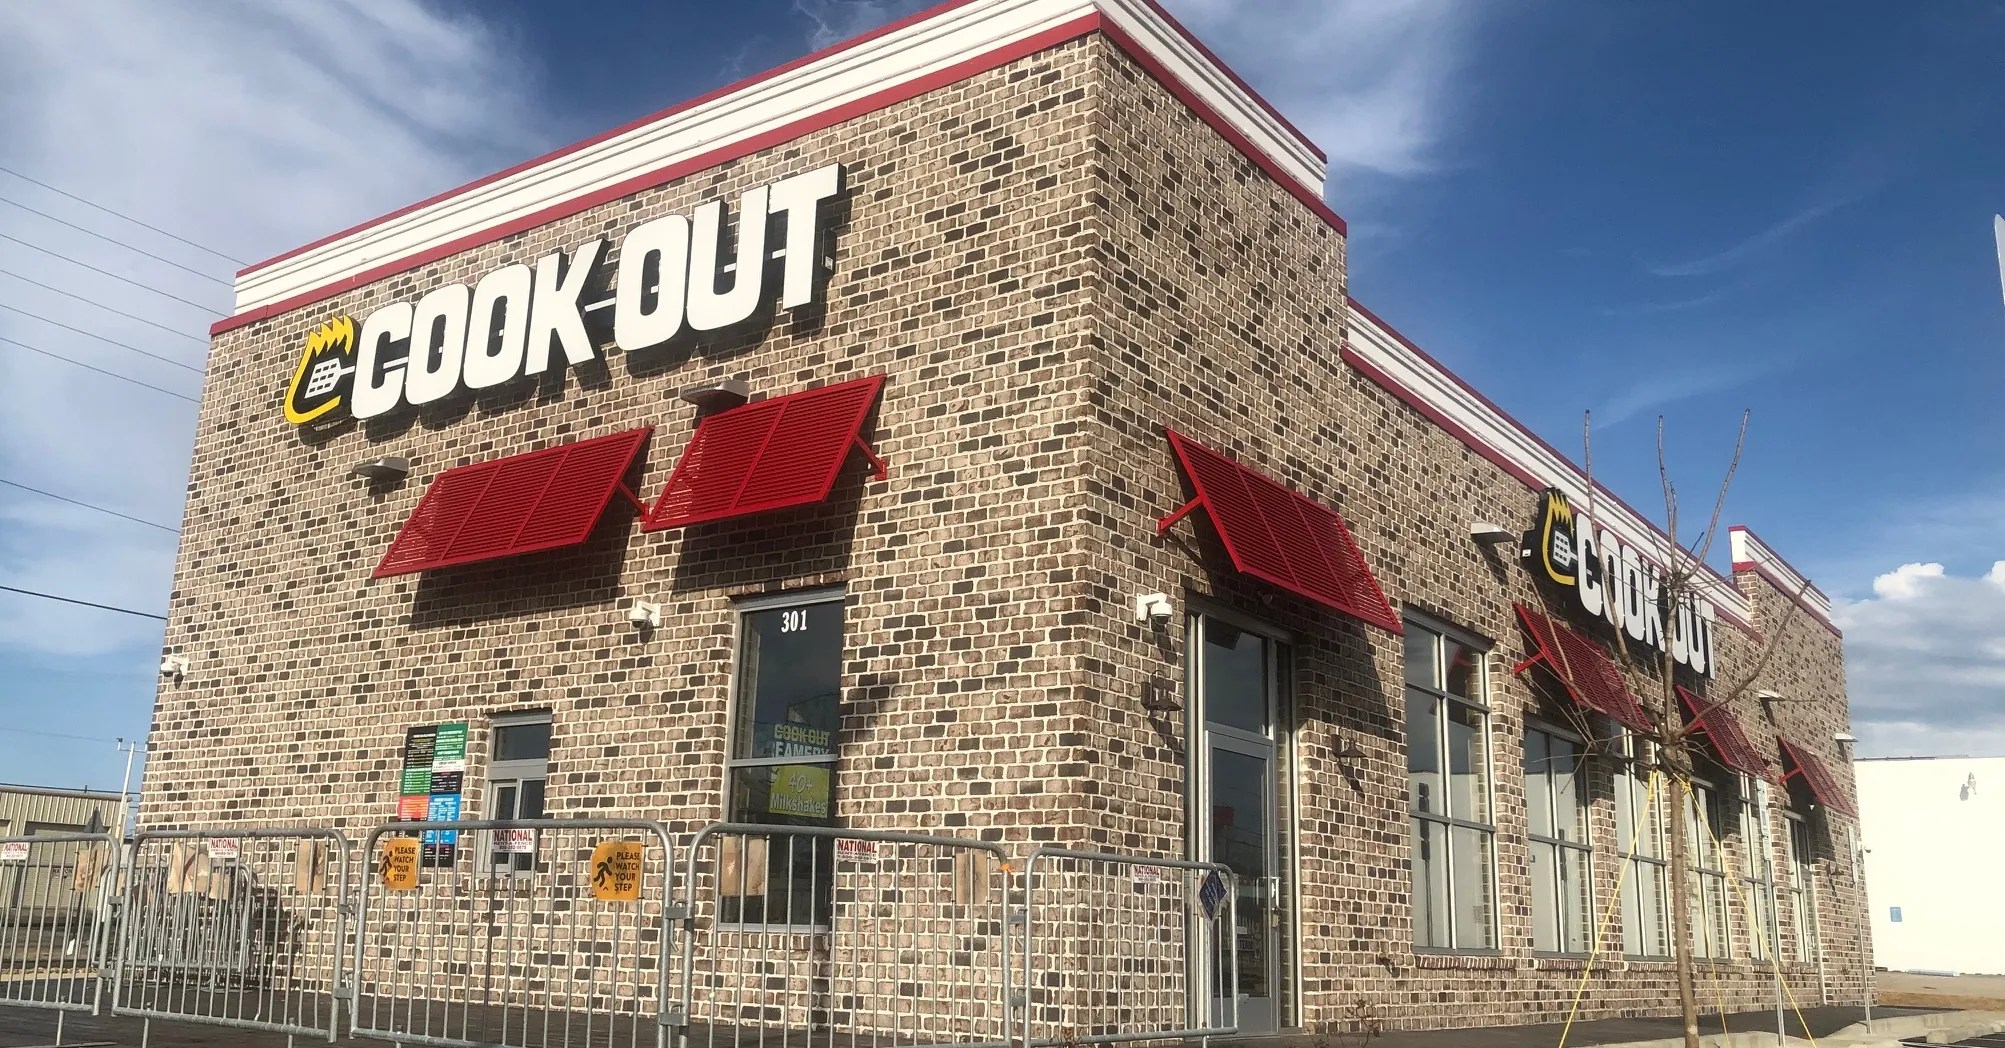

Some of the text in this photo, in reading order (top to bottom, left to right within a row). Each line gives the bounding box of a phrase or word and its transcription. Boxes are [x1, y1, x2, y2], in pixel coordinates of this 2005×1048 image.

[781, 609, 808, 633] 301
[770, 792, 827, 815] Milkshakes
[494, 829, 533, 841] NATIONAL
[211, 839, 238, 849] NATIONAL
[837, 839, 877, 854] NATIONAL
[394, 846, 416, 855] PLEASE
[394, 856, 414, 864] WATCH
[616, 851, 640, 861] PLEASE
[616, 862, 640, 871] WATCH
[393, 874, 406, 882] STEP
[615, 872, 636, 881] YOUR
[614, 883, 632, 892] STEP
